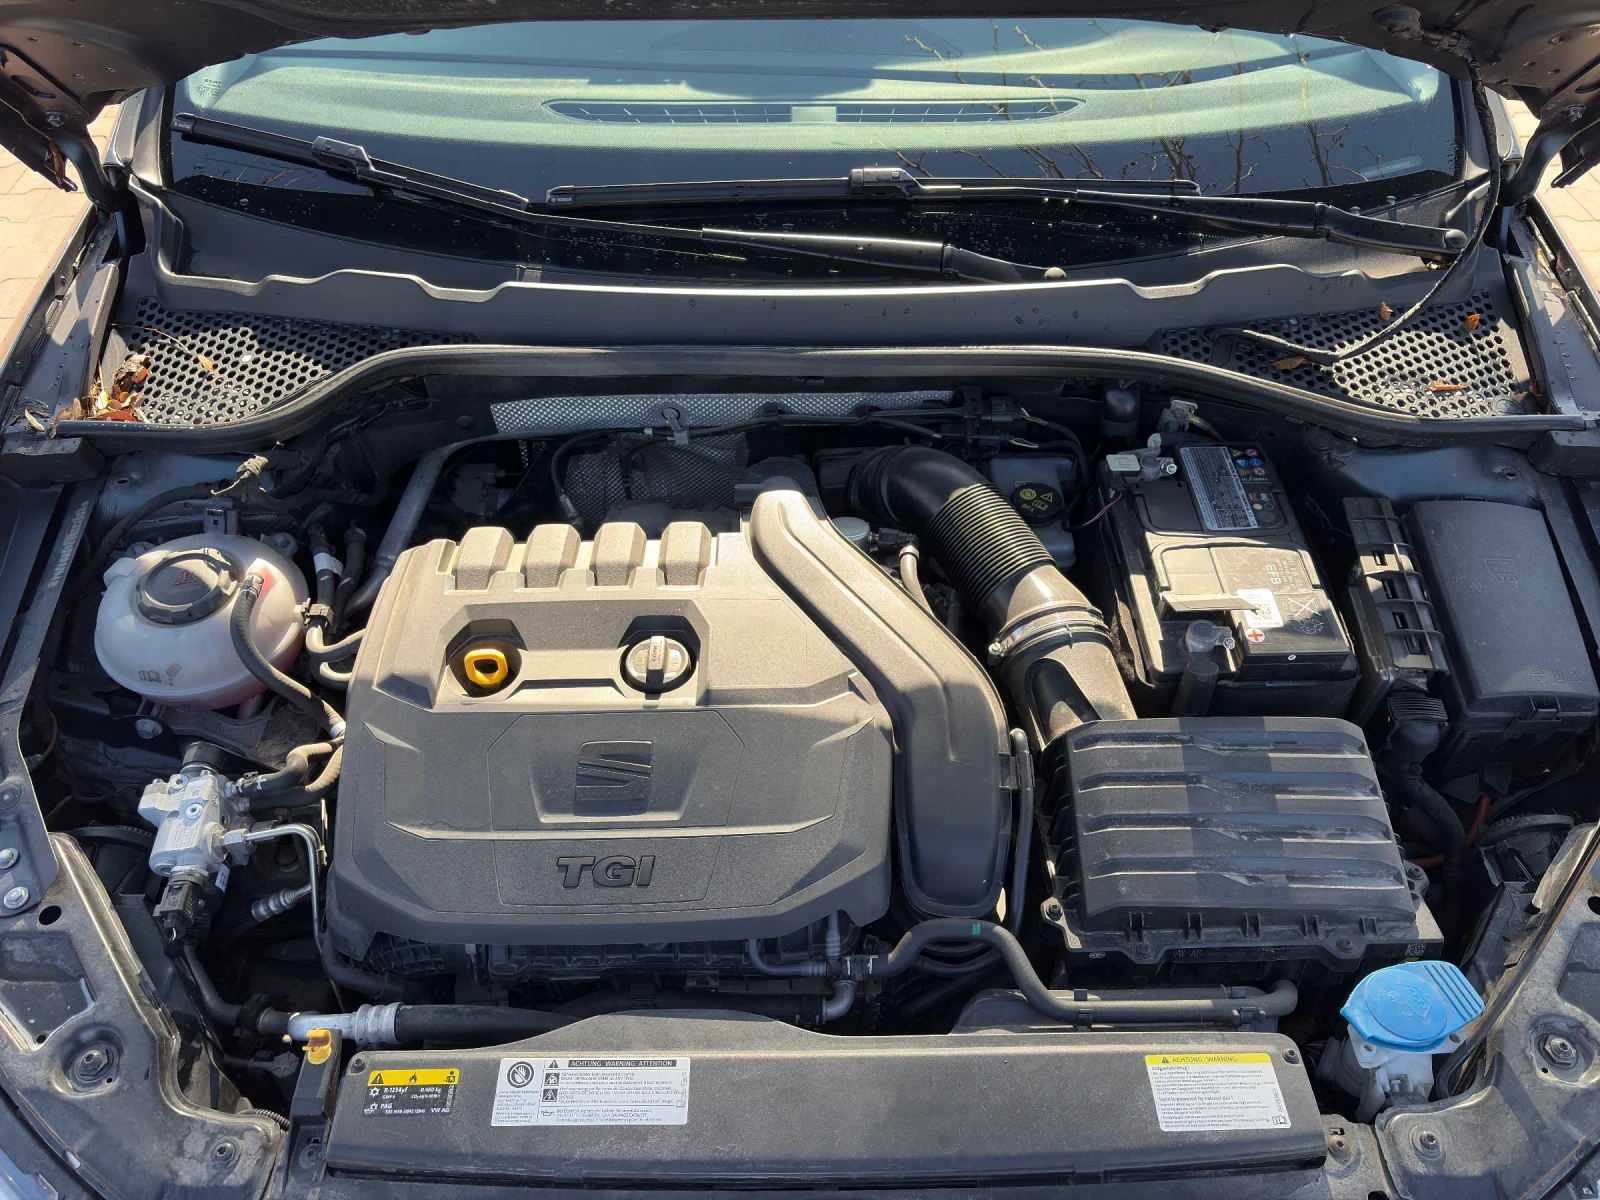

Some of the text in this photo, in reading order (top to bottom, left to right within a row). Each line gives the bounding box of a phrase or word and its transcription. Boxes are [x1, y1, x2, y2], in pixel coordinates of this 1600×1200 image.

[1265, 564, 1282, 585] EFB
[556, 855, 656, 888] TGI
[383, 1086, 408, 1094] R-1234yf
